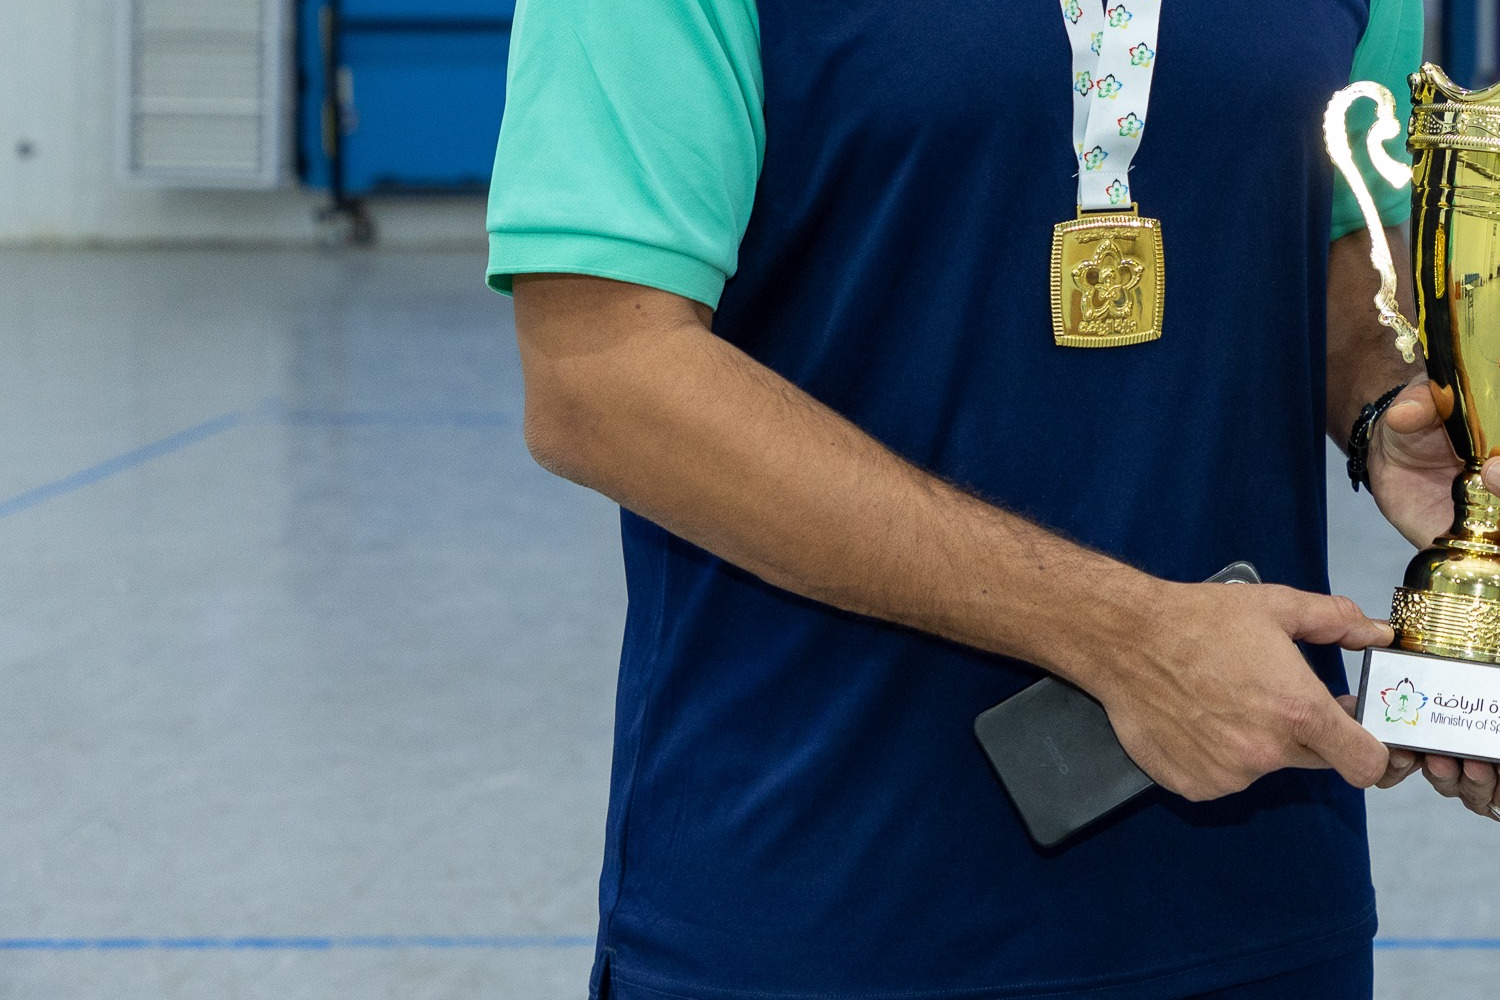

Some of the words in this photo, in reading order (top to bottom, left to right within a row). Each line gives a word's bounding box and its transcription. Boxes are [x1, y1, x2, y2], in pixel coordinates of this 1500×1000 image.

[1433, 692, 1485, 715] الرياضة
[1430, 711, 1473, 731] Ministry
[1475, 719, 1488, 731] of
